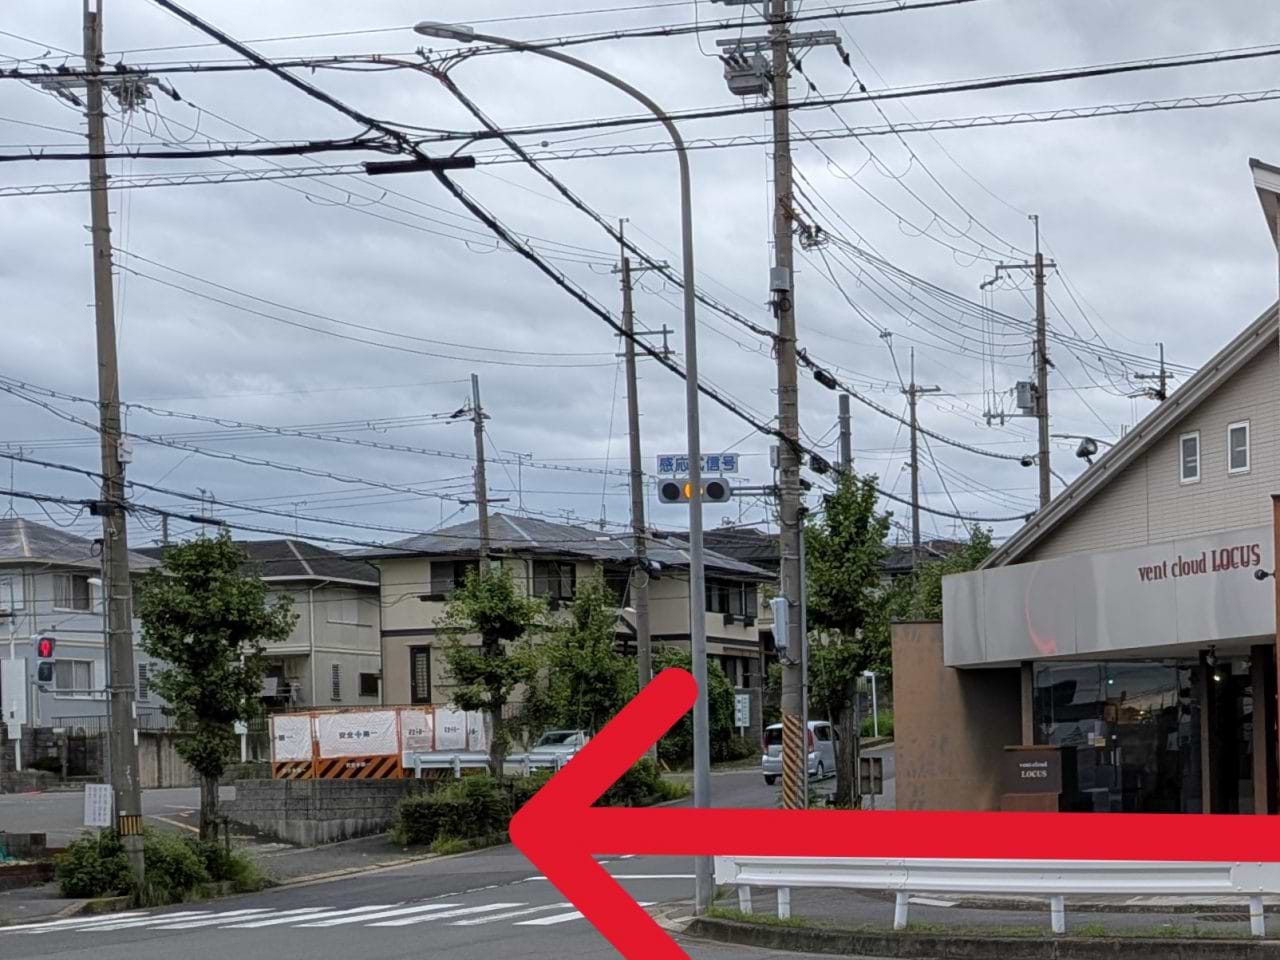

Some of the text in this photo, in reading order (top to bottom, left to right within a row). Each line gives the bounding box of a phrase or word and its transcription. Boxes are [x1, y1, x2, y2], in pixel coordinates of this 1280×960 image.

[660, 456, 736, 473] 感応信号
[1138, 543, 1261, 581] vent cloud LOCUS
